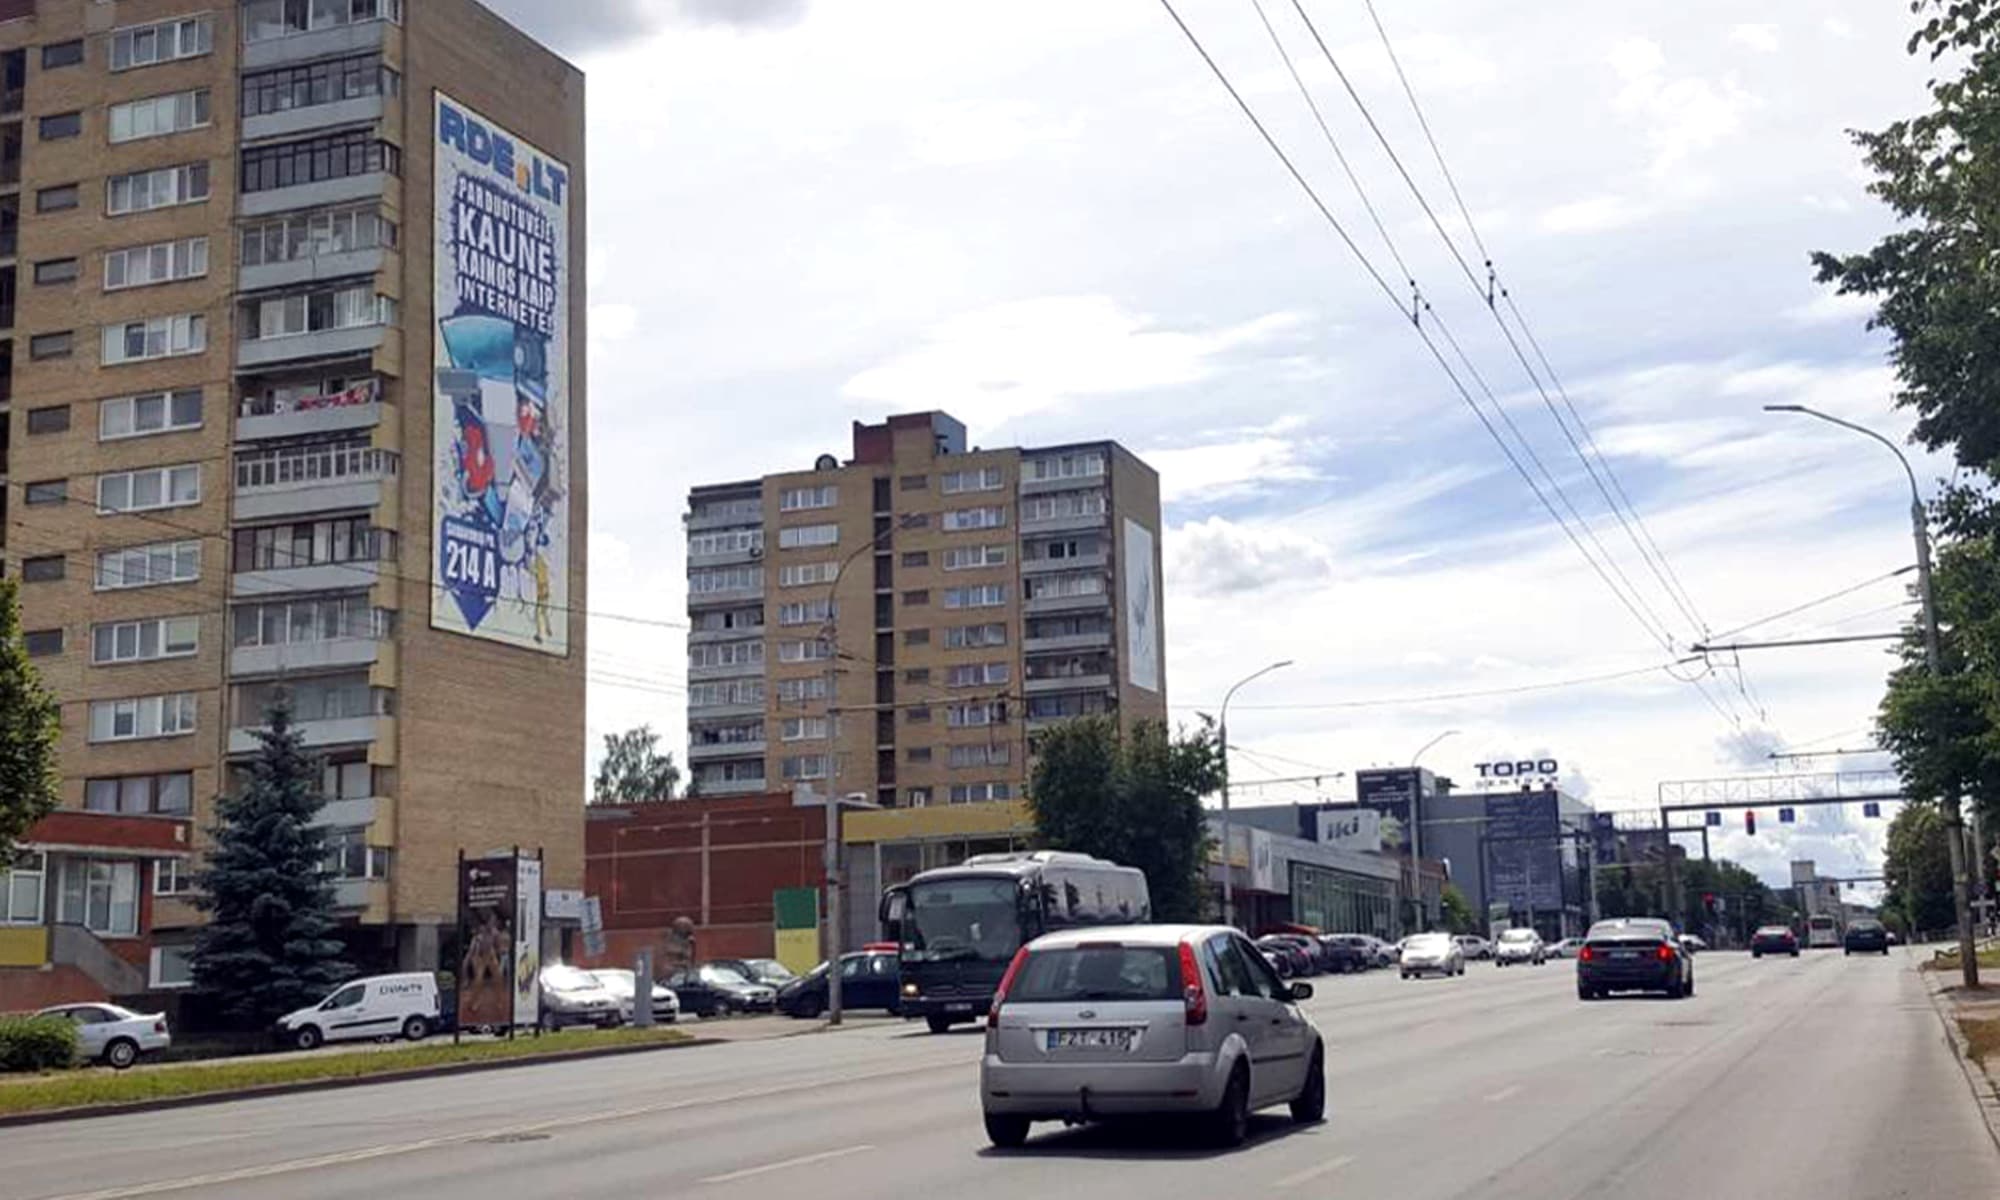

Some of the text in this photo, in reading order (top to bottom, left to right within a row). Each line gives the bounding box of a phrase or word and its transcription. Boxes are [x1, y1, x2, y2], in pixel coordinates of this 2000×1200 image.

[440, 102, 566, 207] RDE.LT
[459, 202, 552, 283] KAUNE
[458, 276, 554, 335] INTERNETE!
[459, 245, 554, 312] KAINOS KAIP
[447, 540, 496, 589] 214 A
[1474, 759, 1558, 777] TOPO
